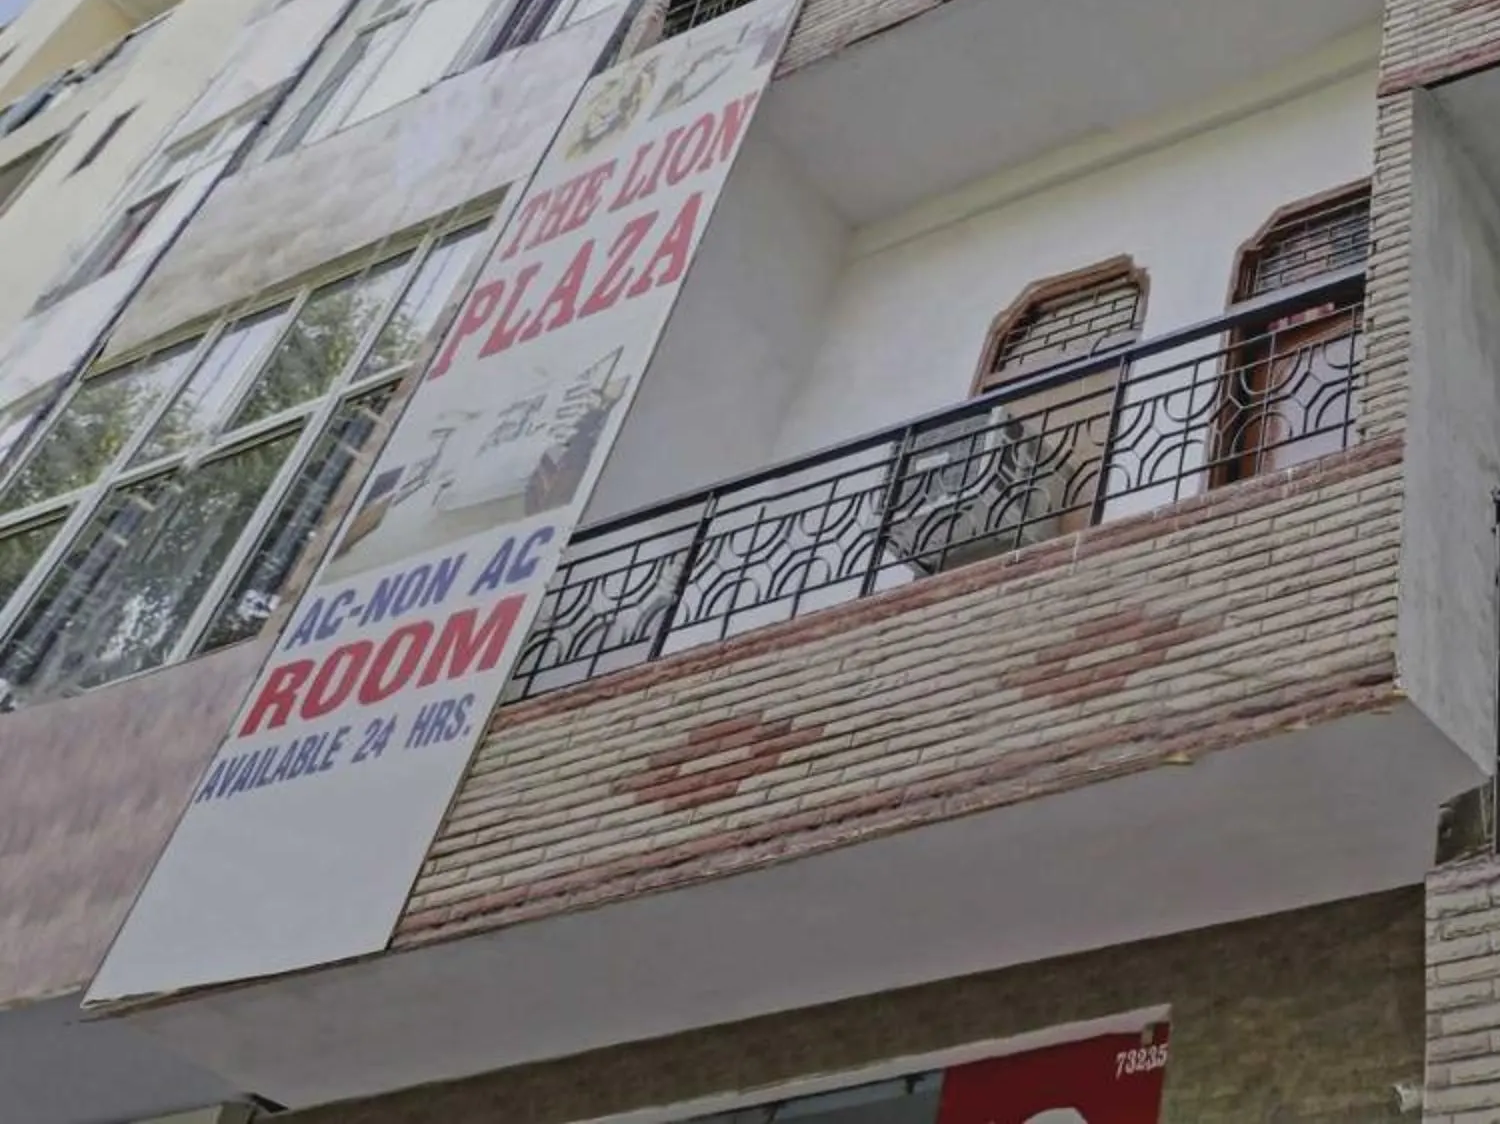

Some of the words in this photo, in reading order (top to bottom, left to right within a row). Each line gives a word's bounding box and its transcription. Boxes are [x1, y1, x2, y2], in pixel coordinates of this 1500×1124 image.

[501, 157, 618, 262] THE
[608, 90, 759, 214] LION
[428, 191, 703, 381] PLAZA
[285, 553, 466, 650] AC-NON
[468, 526, 555, 597] AC
[238, 594, 527, 738] ROOM
[195, 725, 350, 804] AVAILABLE
[351, 714, 398, 764] 24
[404, 694, 475, 749] HRS.
